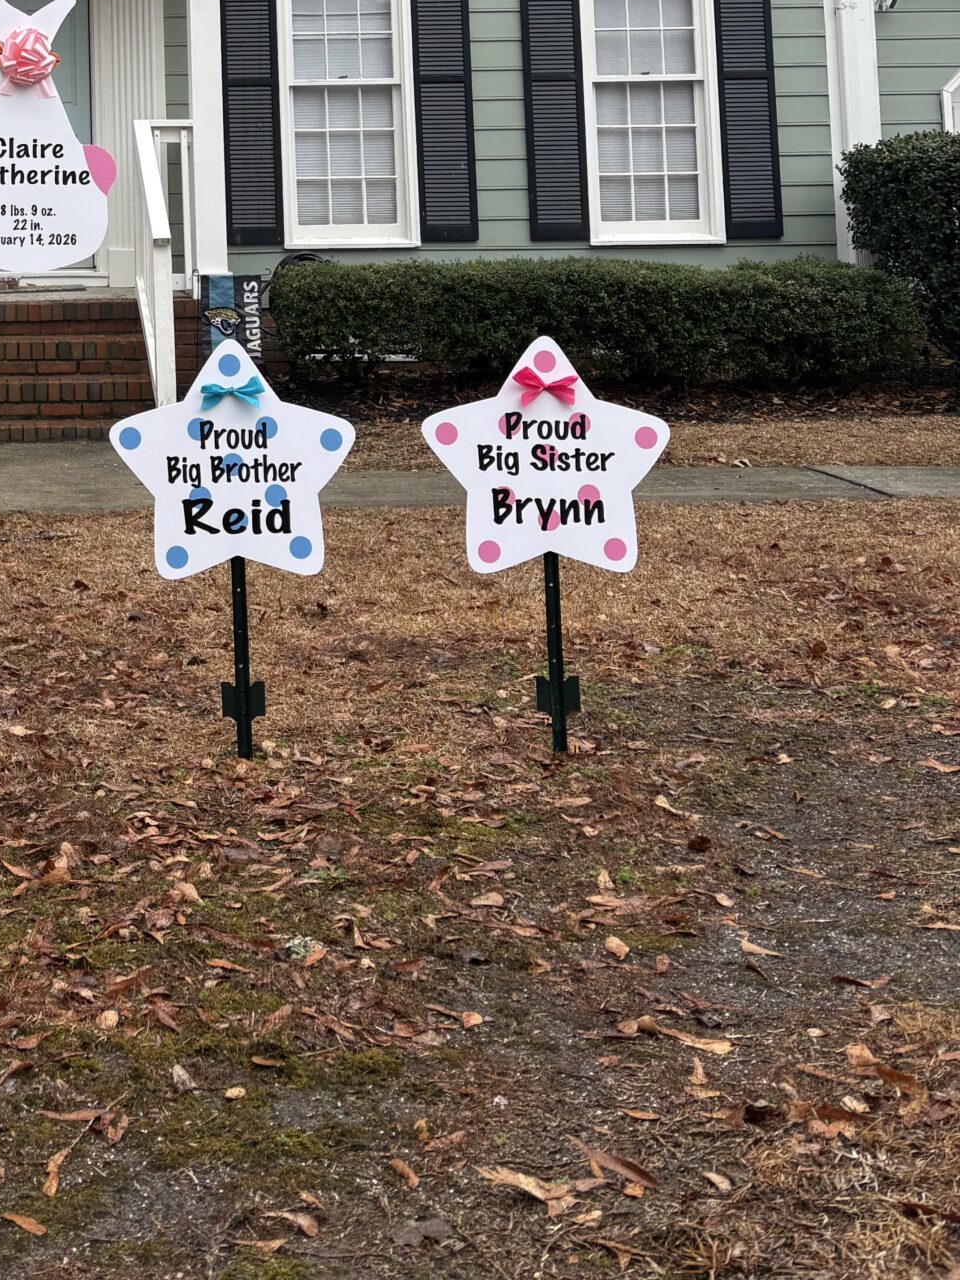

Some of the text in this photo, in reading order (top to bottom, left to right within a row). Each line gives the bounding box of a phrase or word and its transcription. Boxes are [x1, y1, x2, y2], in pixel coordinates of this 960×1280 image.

[0, 204, 56, 217] 8 lbs. 9 oz.
[12, 219, 43, 231] 22 in.
[29, 233, 45, 247] 14,
[48, 233, 77, 246] 2026
[199, 420, 268, 450] Proud
[504, 411, 587, 441] Proud
[166, 454, 303, 488] Big Brother
[477, 443, 615, 476] Big Sister
[181, 497, 292, 535] Reid
[491, 487, 606, 532] Brynn
